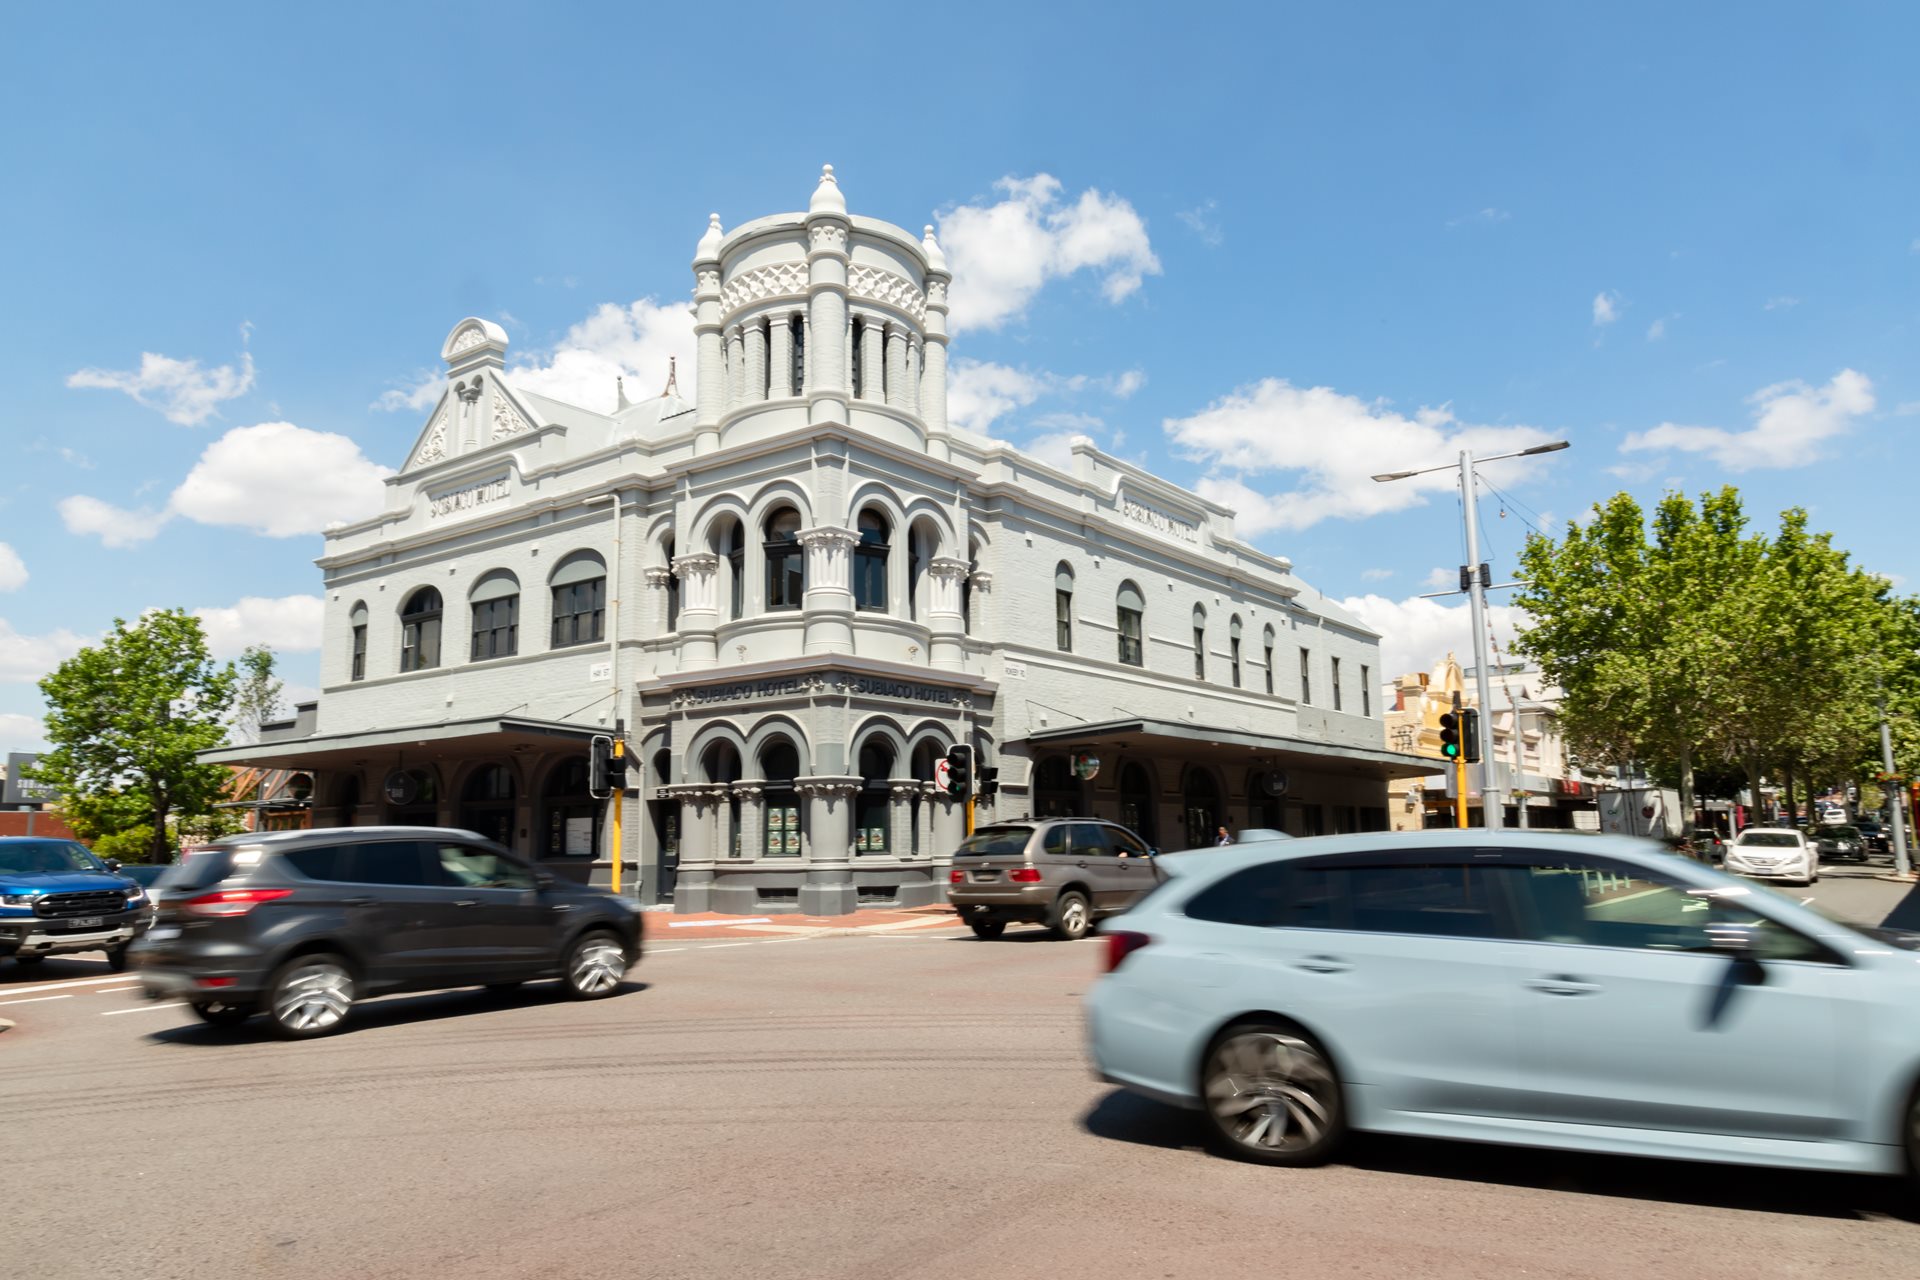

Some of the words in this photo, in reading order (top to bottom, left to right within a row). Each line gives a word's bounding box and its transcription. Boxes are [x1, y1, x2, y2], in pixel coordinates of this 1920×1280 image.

[697, 685, 753, 704] SUBIACO
[757, 678, 802, 698] HOTEL
[858, 680, 912, 699] SUBIACO
[914, 686, 953, 704] HOTEL
